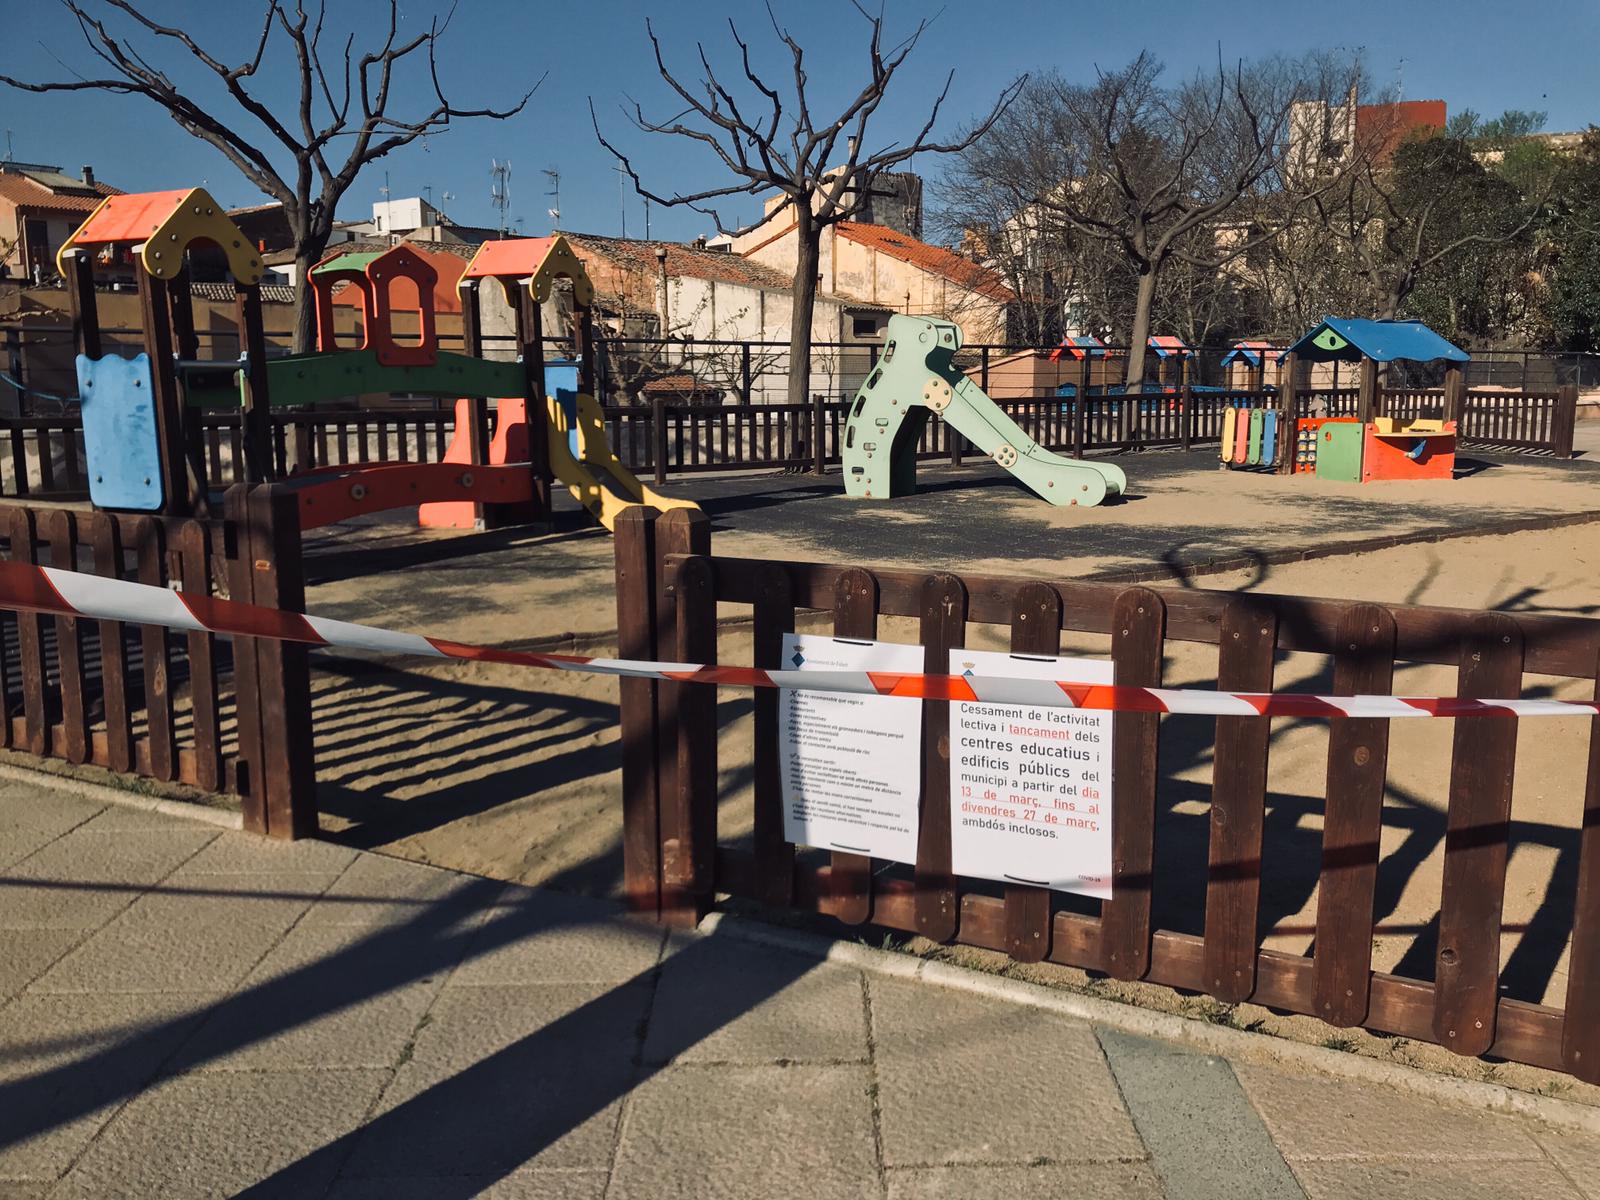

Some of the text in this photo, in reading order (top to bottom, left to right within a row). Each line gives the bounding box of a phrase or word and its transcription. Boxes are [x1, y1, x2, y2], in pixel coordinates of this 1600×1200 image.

[960, 703, 1100, 727] Cessament de l'activitat
[960, 718, 1100, 743] lectiva i tancament dels
[960, 737, 1100, 762] centres educatius i
[961, 755, 1100, 782] edificis públics del
[961, 773, 1100, 799] municipi a partir del dia
[961, 786, 1100, 815] 13 de març, fins al
[961, 801, 1100, 832] divendres 27 de març,
[962, 817, 1058, 839] ambdós inclosos.
